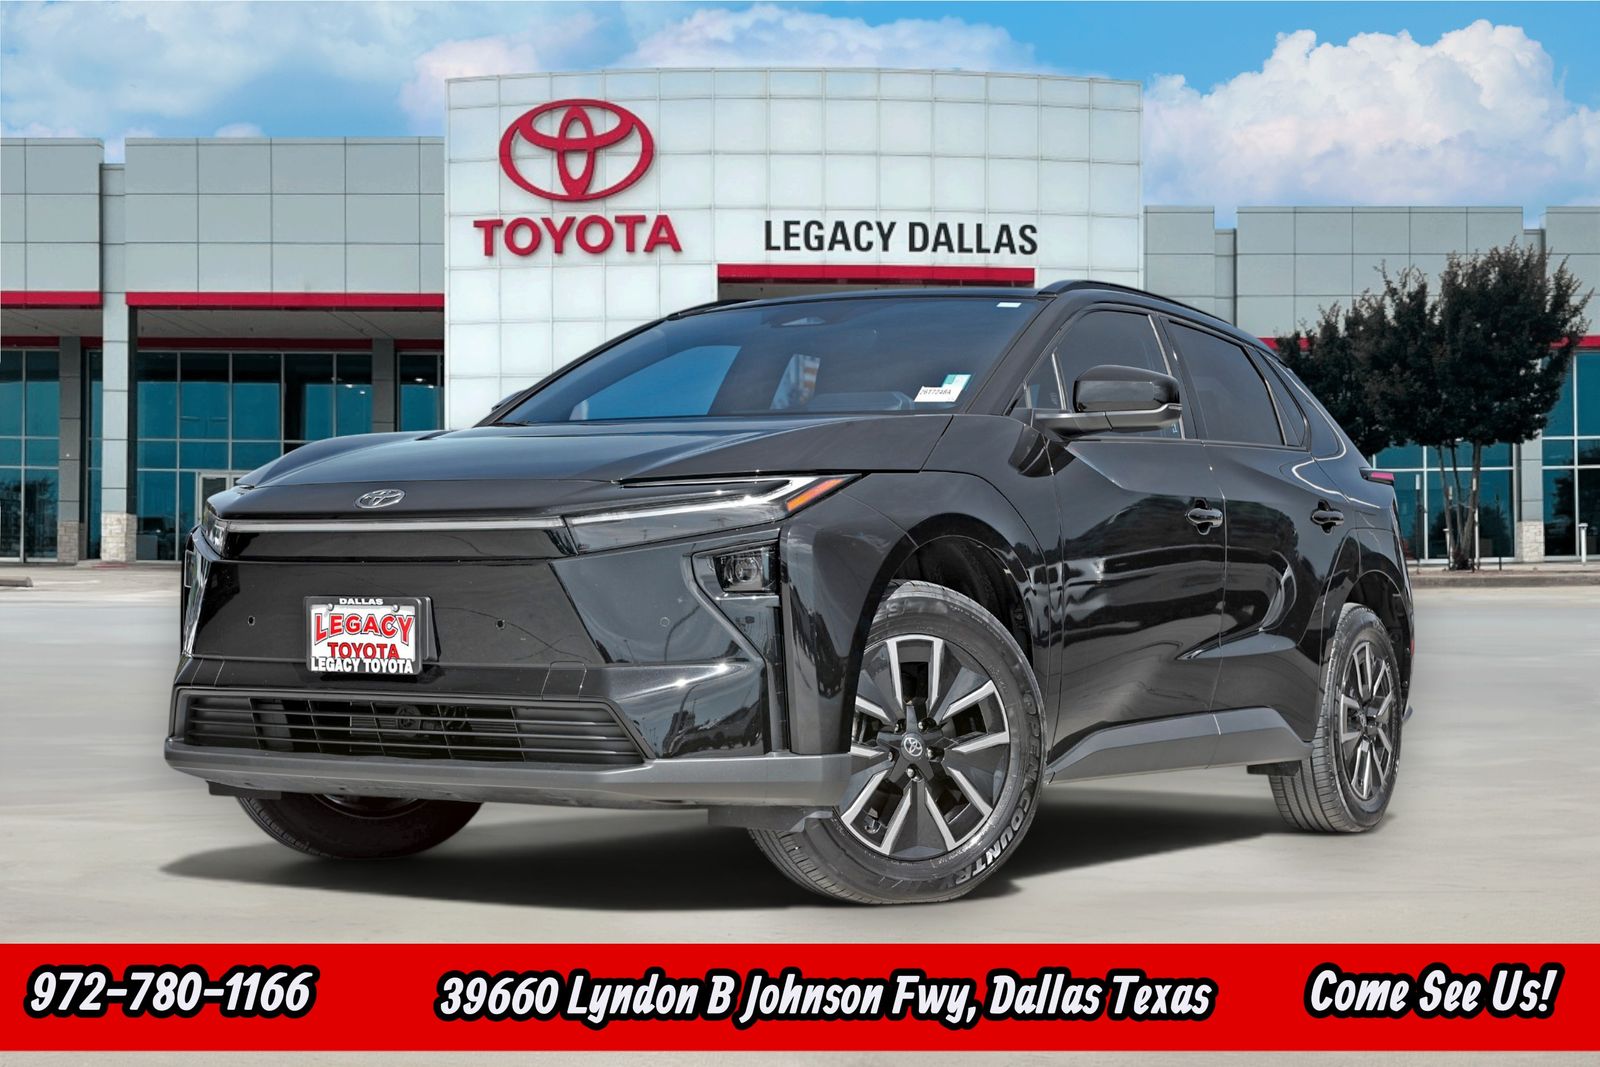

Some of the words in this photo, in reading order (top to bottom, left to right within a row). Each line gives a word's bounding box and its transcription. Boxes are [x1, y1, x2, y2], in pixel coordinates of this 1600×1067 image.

[474, 214, 682, 257] TOYOTA
[765, 220, 897, 252] LEGACY
[908, 221, 1038, 255] DALLAS
[339, 598, 384, 606] DALLAS
[313, 613, 415, 646] LEGACY
[327, 642, 400, 660] TOYOTA
[310, 656, 361, 673] LEGACY
[362, 658, 414, 674] TOYOTA
